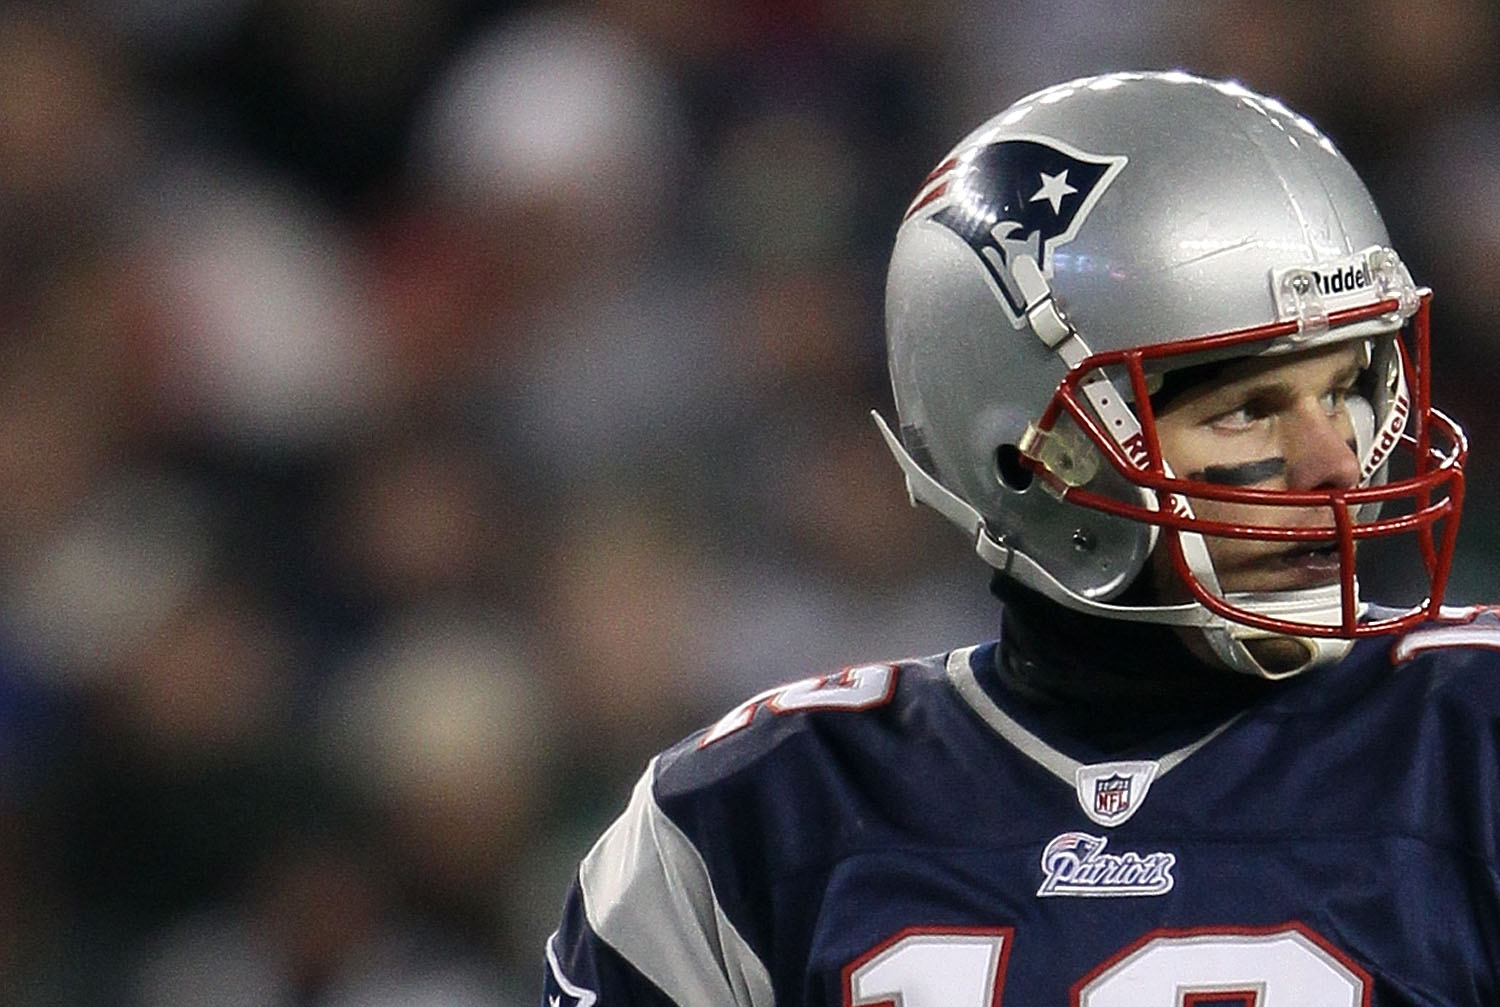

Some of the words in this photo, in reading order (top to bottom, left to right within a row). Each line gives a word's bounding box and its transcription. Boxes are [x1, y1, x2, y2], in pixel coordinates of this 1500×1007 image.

[1357, 393, 1409, 487] iddell
[1098, 790, 1128, 812] NFL
[1041, 848, 1172, 893] Patriots
